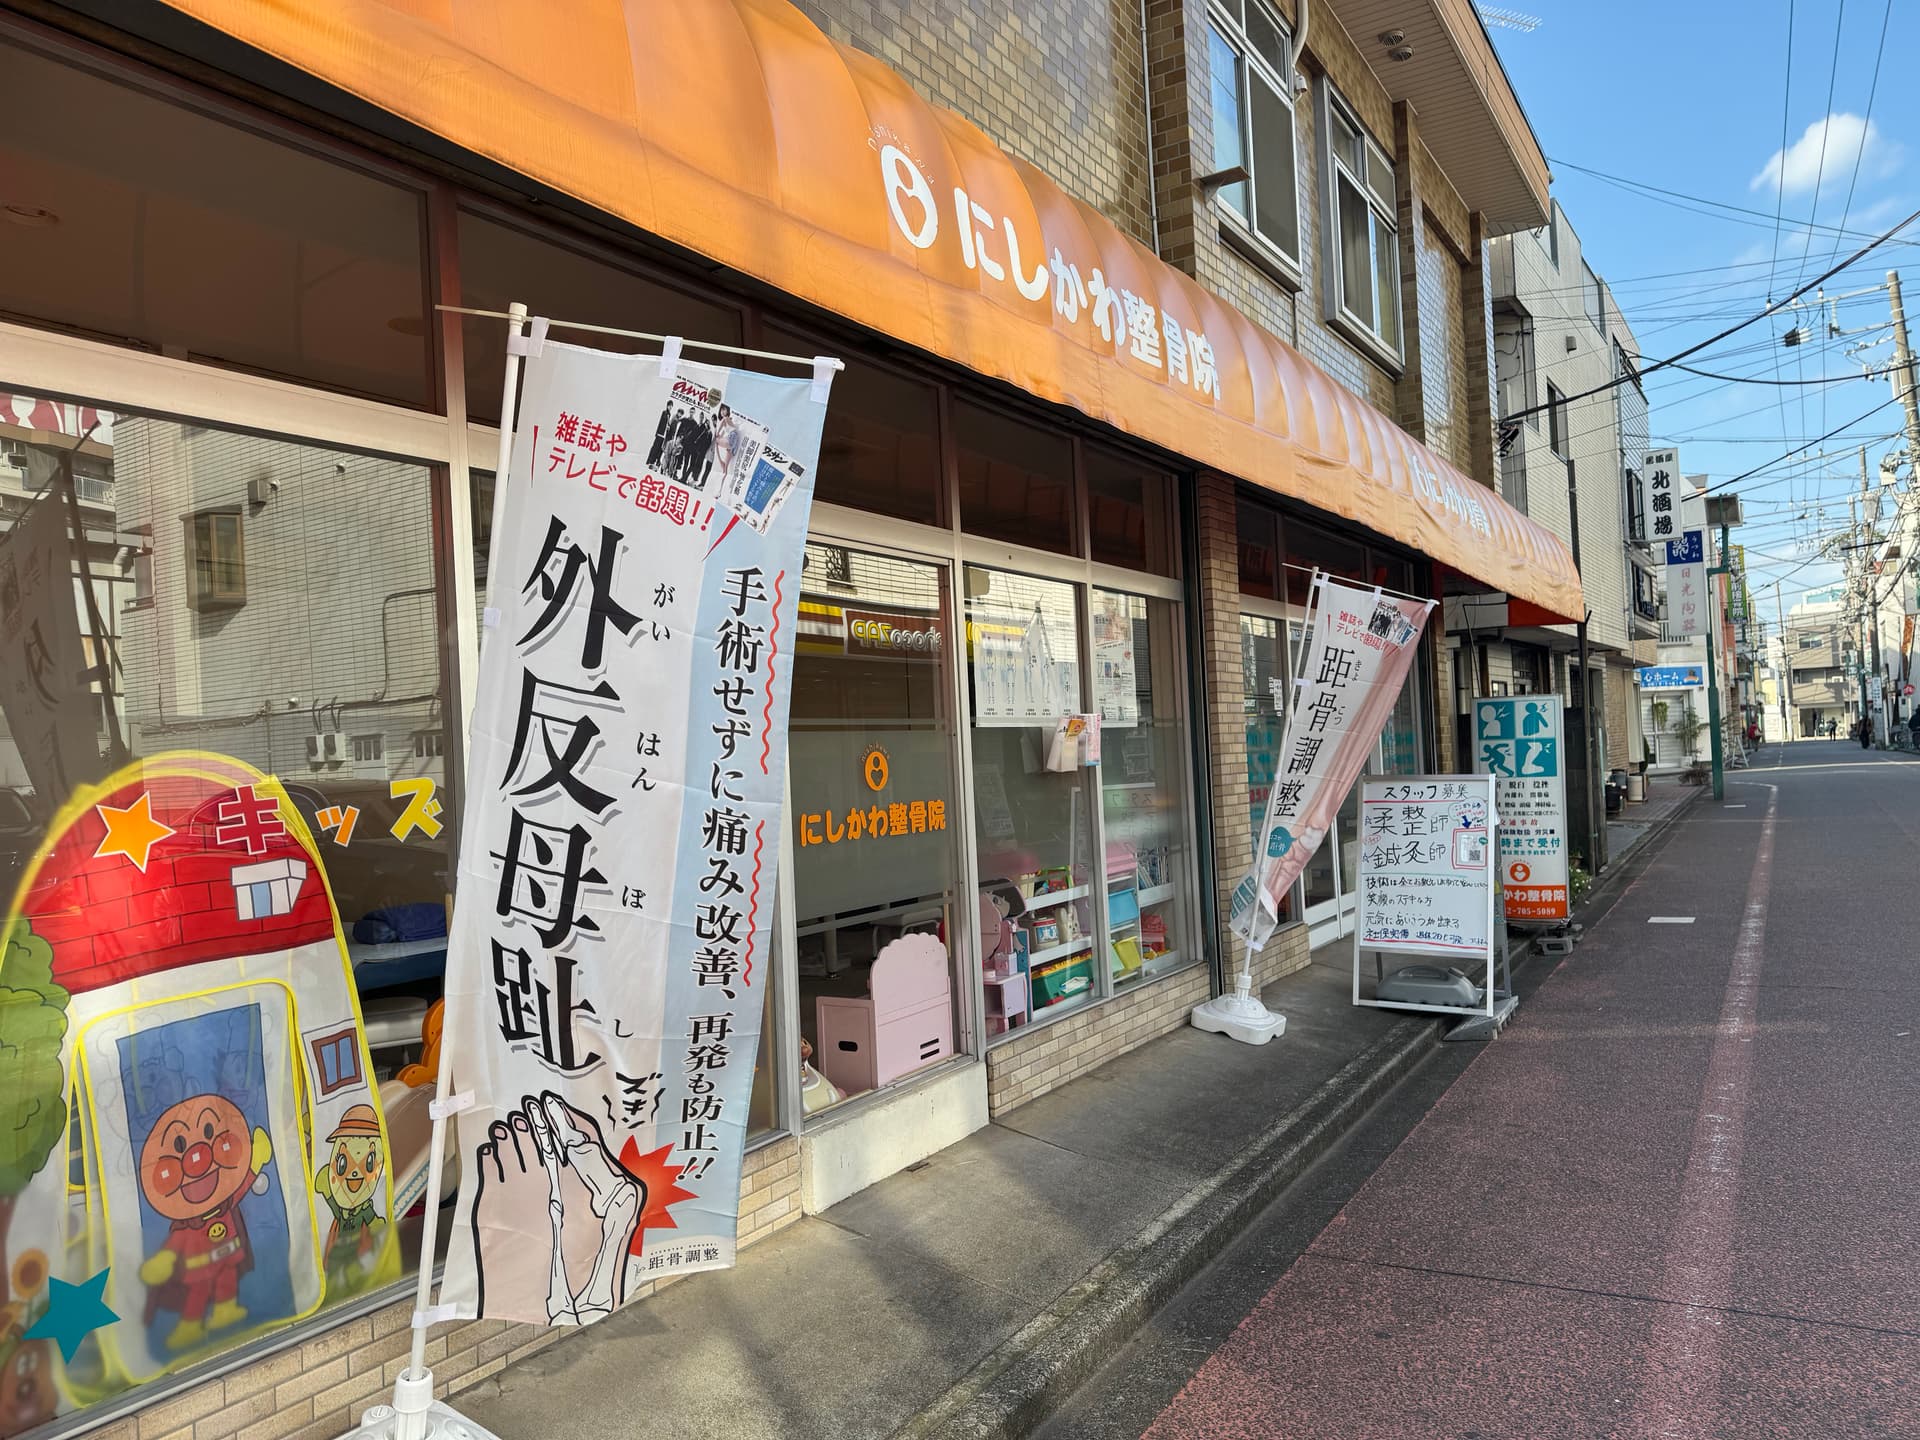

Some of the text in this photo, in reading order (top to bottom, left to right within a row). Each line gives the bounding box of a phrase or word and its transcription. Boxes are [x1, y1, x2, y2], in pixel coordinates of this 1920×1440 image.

[954, 187, 1221, 400] にしかわ整骨院
[555, 411, 628, 458] 雑誌や
[548, 448, 715, 531] テレビで話題!!
[1652, 470, 1673, 535] 北酒場
[653, 582, 676, 641] がい
[1273, 645, 1355, 817] 距骨調整
[631, 731, 662, 792] はん
[216, 777, 443, 855] キッズ
[489, 514, 643, 1072] 外反母趾
[1500, 818, 1538, 826] 交通事故
[801, 800, 945, 847] にしかわ整骨院
[1370, 841, 1446, 869] 鍼灸師
[615, 1071, 663, 1130] ズキン
[648, 1247, 719, 1270] 距骨調整
